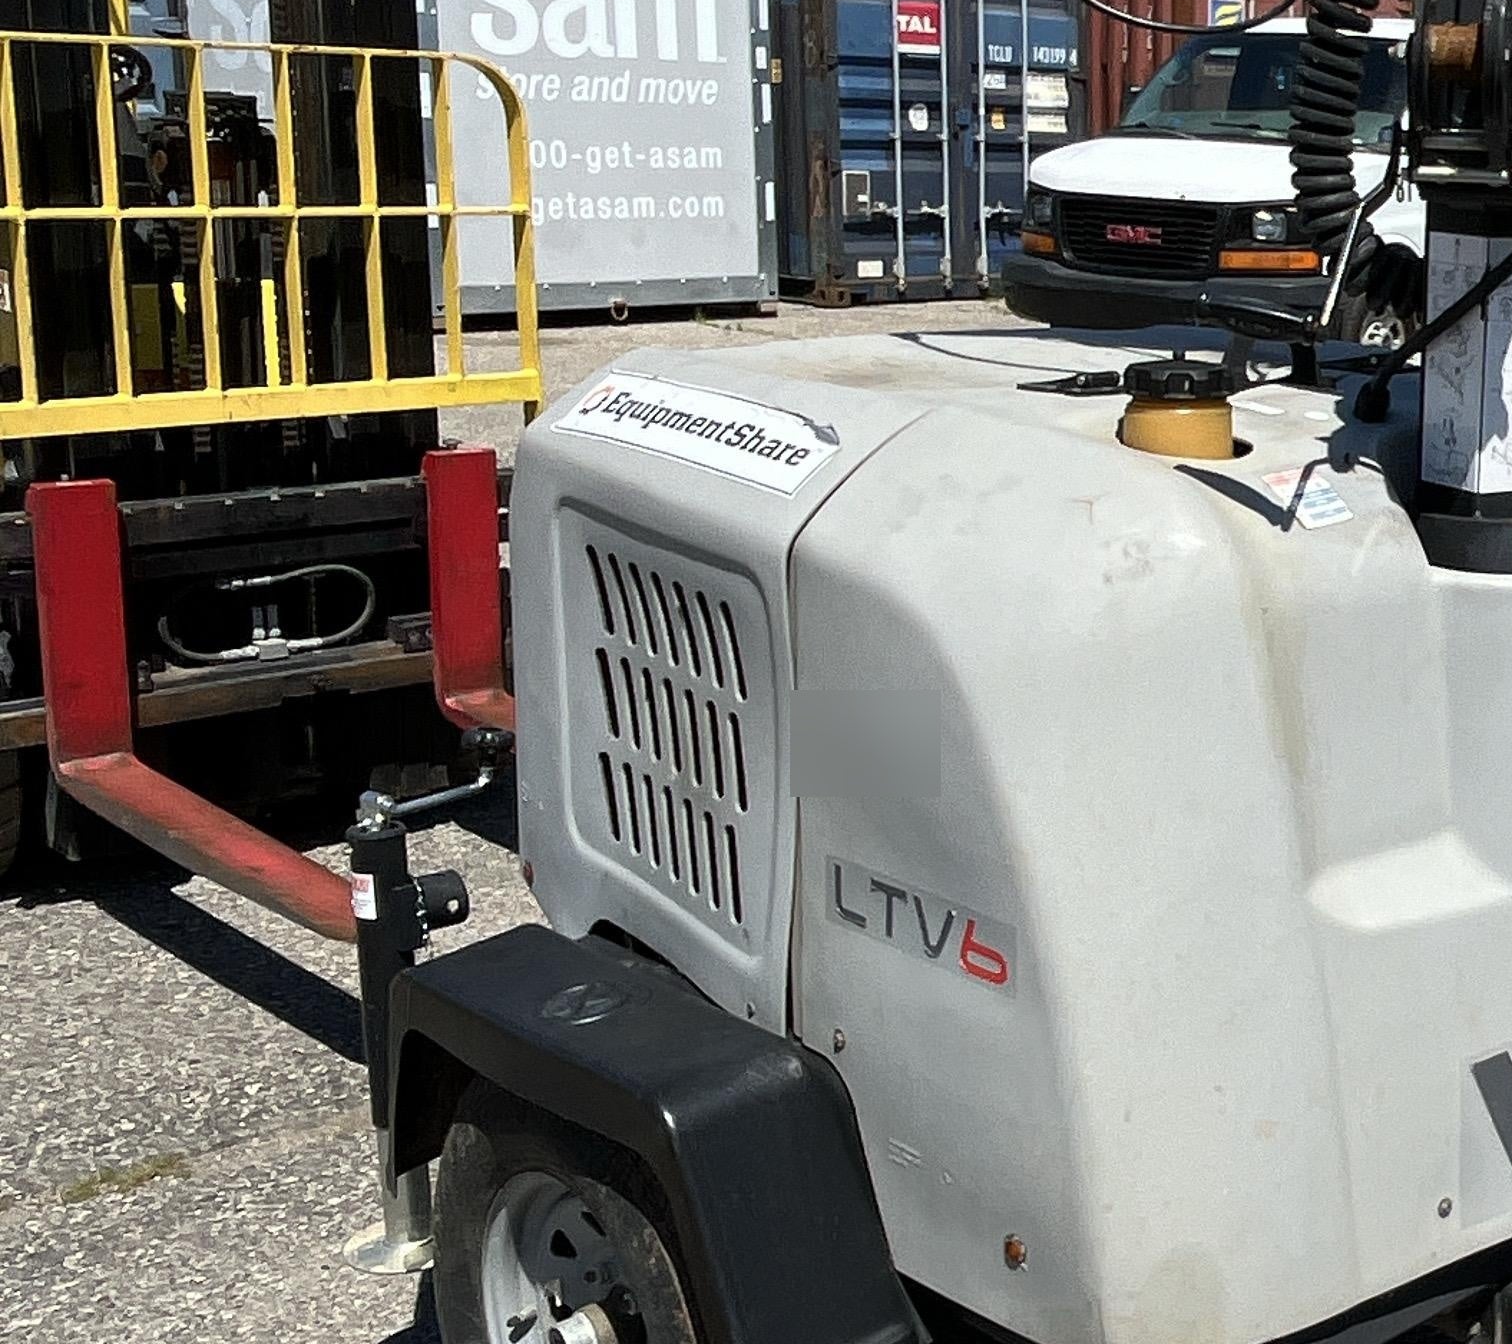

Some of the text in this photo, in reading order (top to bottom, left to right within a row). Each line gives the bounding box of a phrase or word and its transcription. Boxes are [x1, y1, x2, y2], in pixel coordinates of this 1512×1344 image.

[896, 14, 937, 35] TAL
[476, 64, 719, 106] sore and move
[1106, 224, 1162, 245] GMC
[602, 391, 811, 467] EquipmentShare
[833, 863, 1009, 985] LTV6
